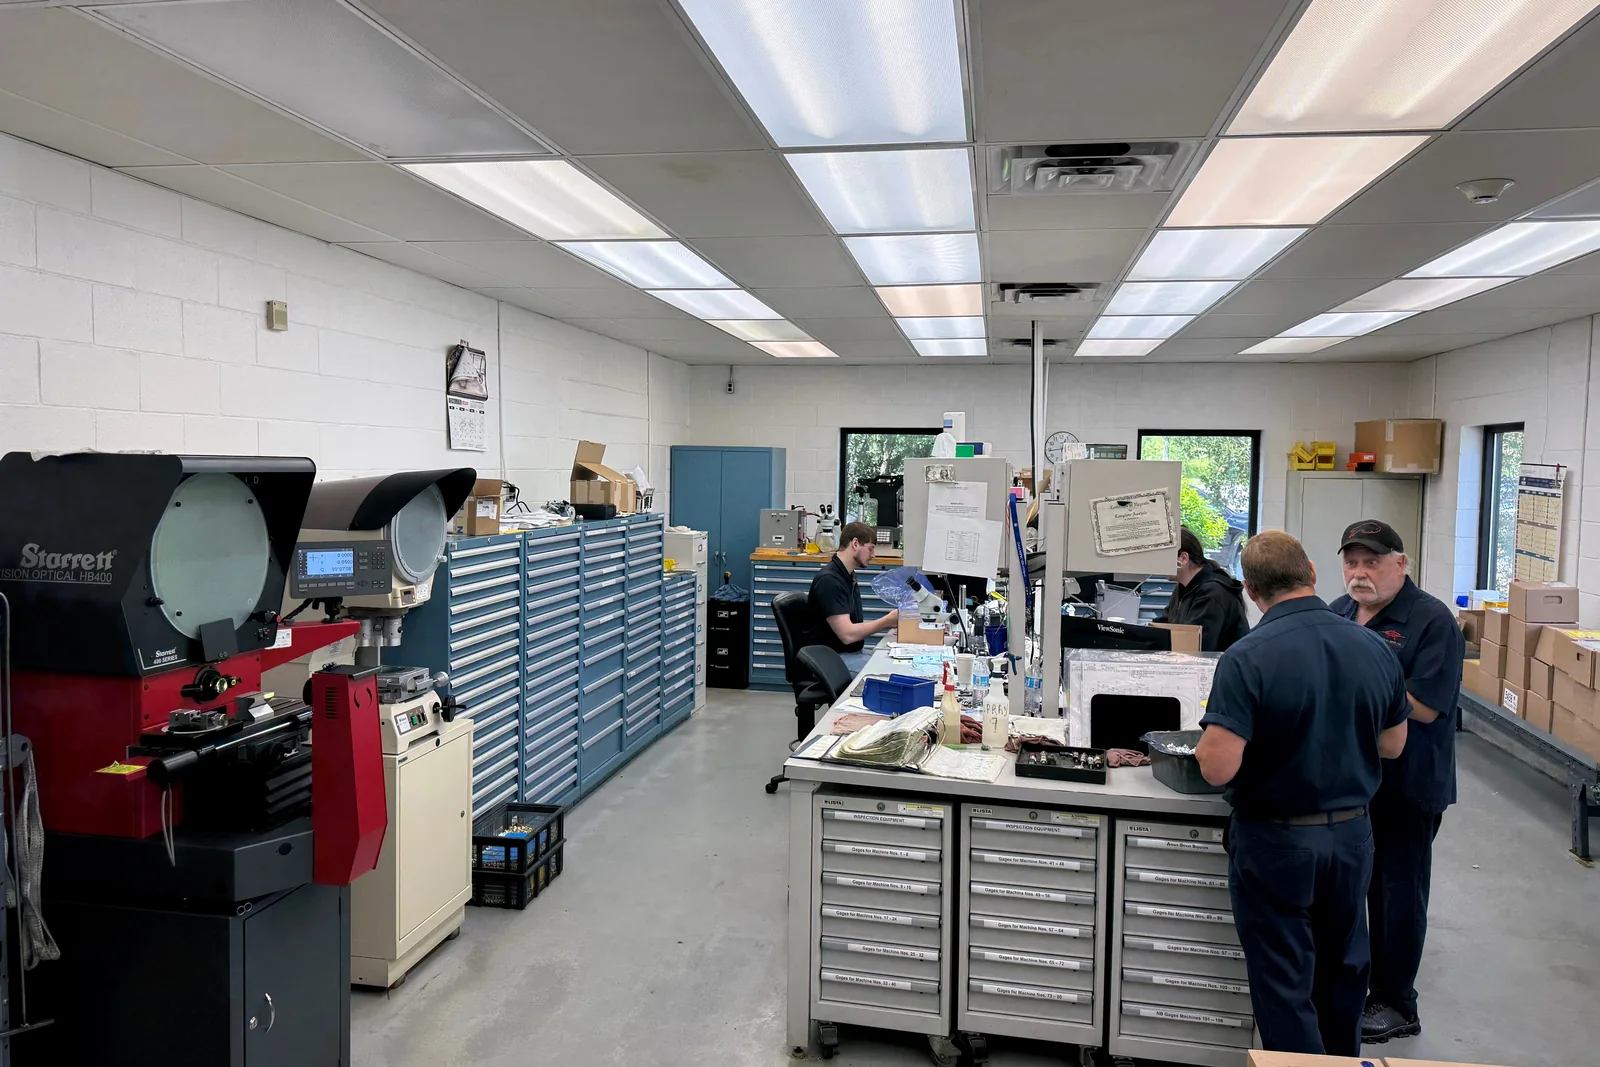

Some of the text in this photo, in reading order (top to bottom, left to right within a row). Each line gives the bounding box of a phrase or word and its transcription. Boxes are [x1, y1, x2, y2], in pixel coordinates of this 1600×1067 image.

[20, 543, 114, 571] Starrett
[0, 568, 113, 583] ISION OPTICAL HB400
[1097, 624, 1125, 634] ViewSonic
[984, 703, 1009, 717] PRAY
